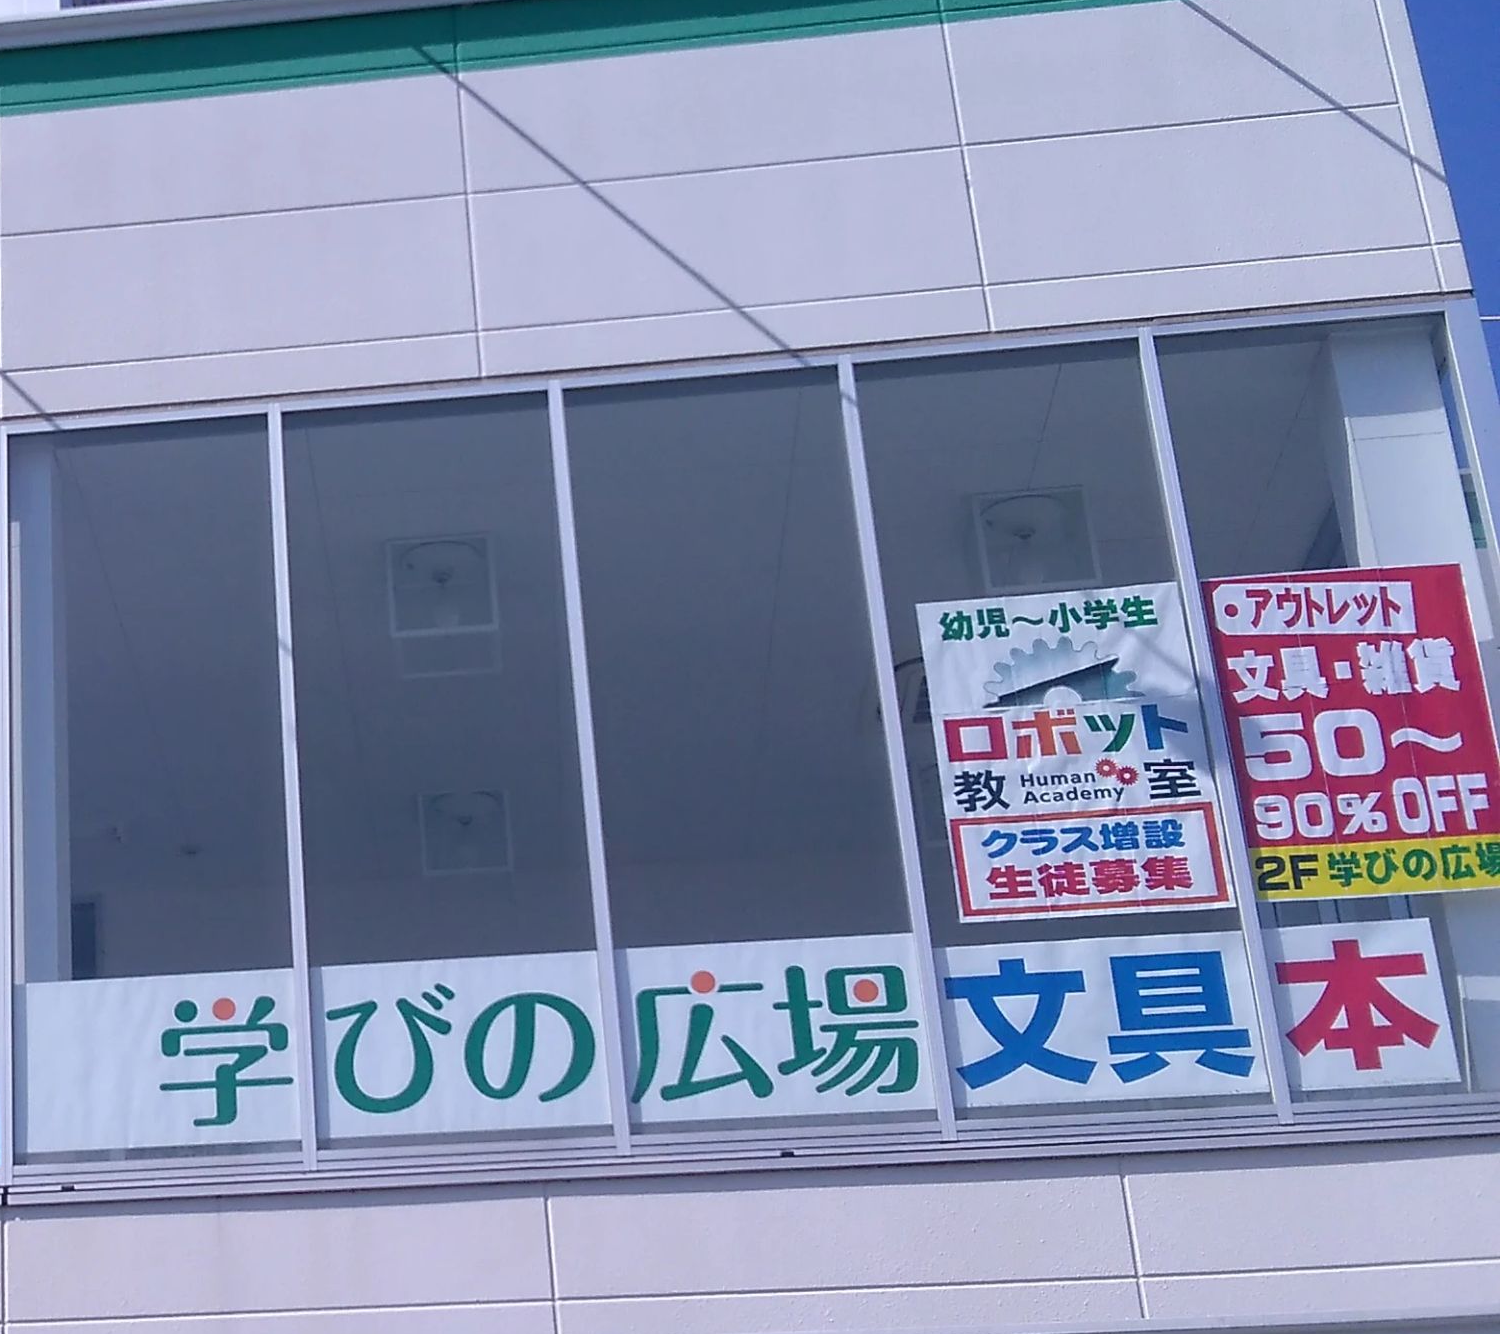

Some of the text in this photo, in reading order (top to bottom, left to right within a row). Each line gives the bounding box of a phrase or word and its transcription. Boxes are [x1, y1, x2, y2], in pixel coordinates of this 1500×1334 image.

[1244, 585, 1402, 629] アウトレット
[1227, 638, 1461, 704] 文具・雑貨
[944, 703, 1189, 764] ロボット
[1019, 770, 1097, 787] Human
[1022, 785, 1125, 805] Academy
[980, 818, 1187, 858] クラス増設
[985, 855, 1194, 899] 生徒募集
[943, 949, 1256, 1091] 文具
[1274, 938, 1441, 1072] 本
[160, 964, 920, 1127] 学びの広場
